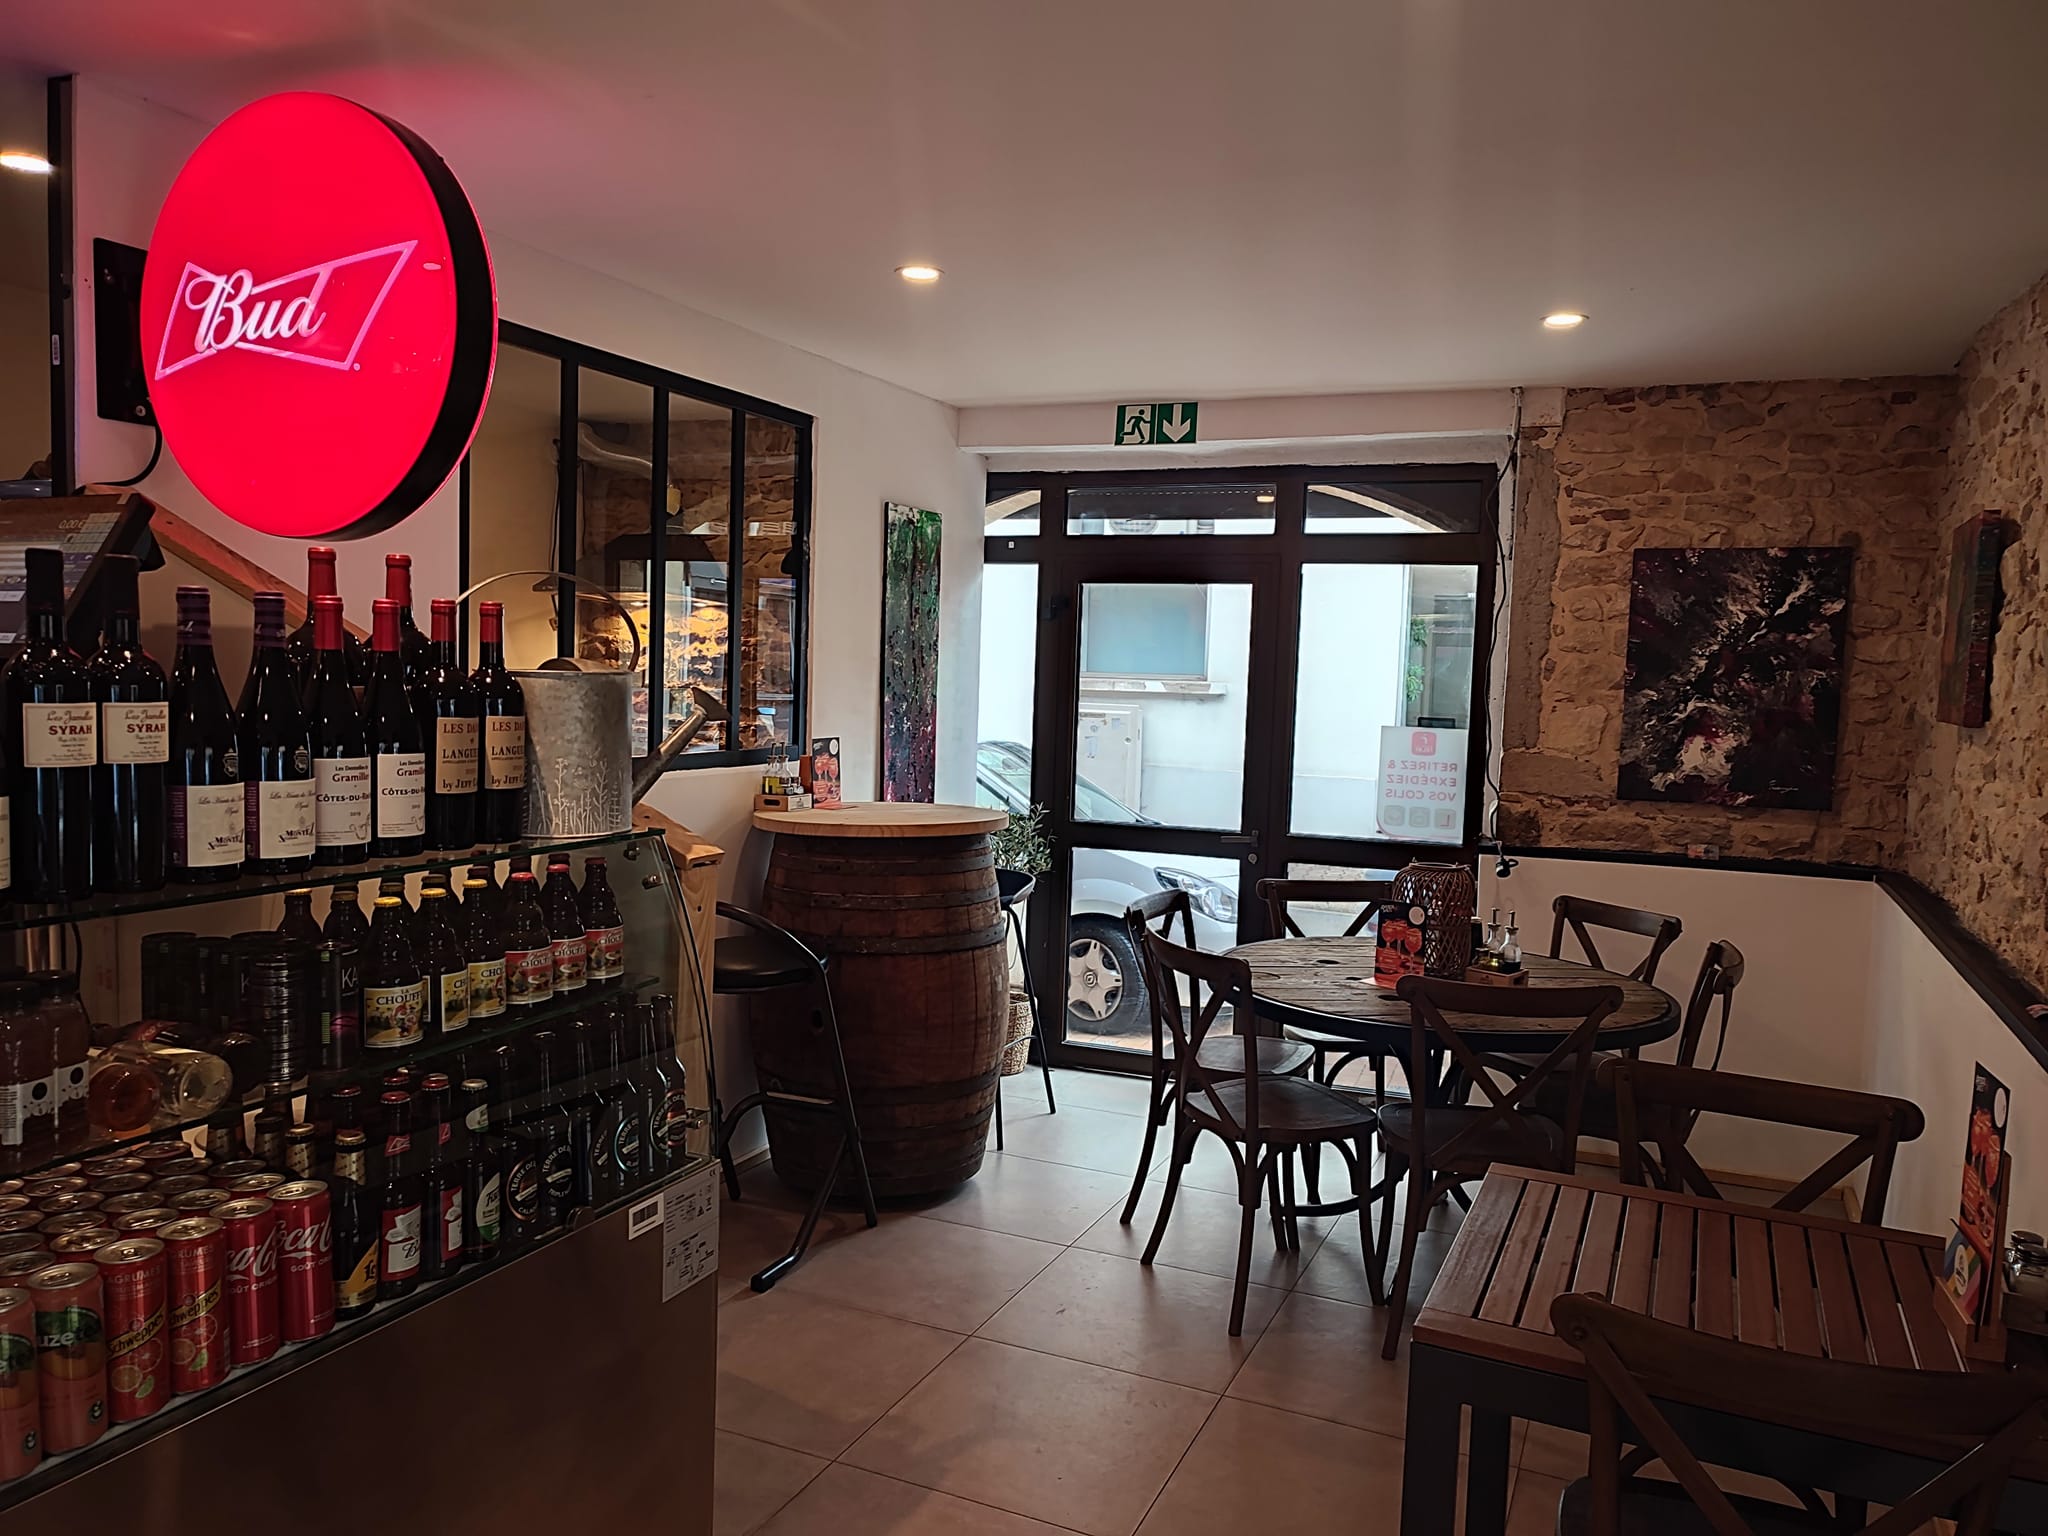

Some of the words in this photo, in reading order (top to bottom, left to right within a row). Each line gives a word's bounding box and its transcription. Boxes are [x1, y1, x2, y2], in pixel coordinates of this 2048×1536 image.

[185, 266, 333, 352] Bud
[48, 725, 93, 735] SYRAH
[126, 723, 166, 734] SYRAH
[443, 723, 464, 734] LES
[492, 721, 511, 731] LES
